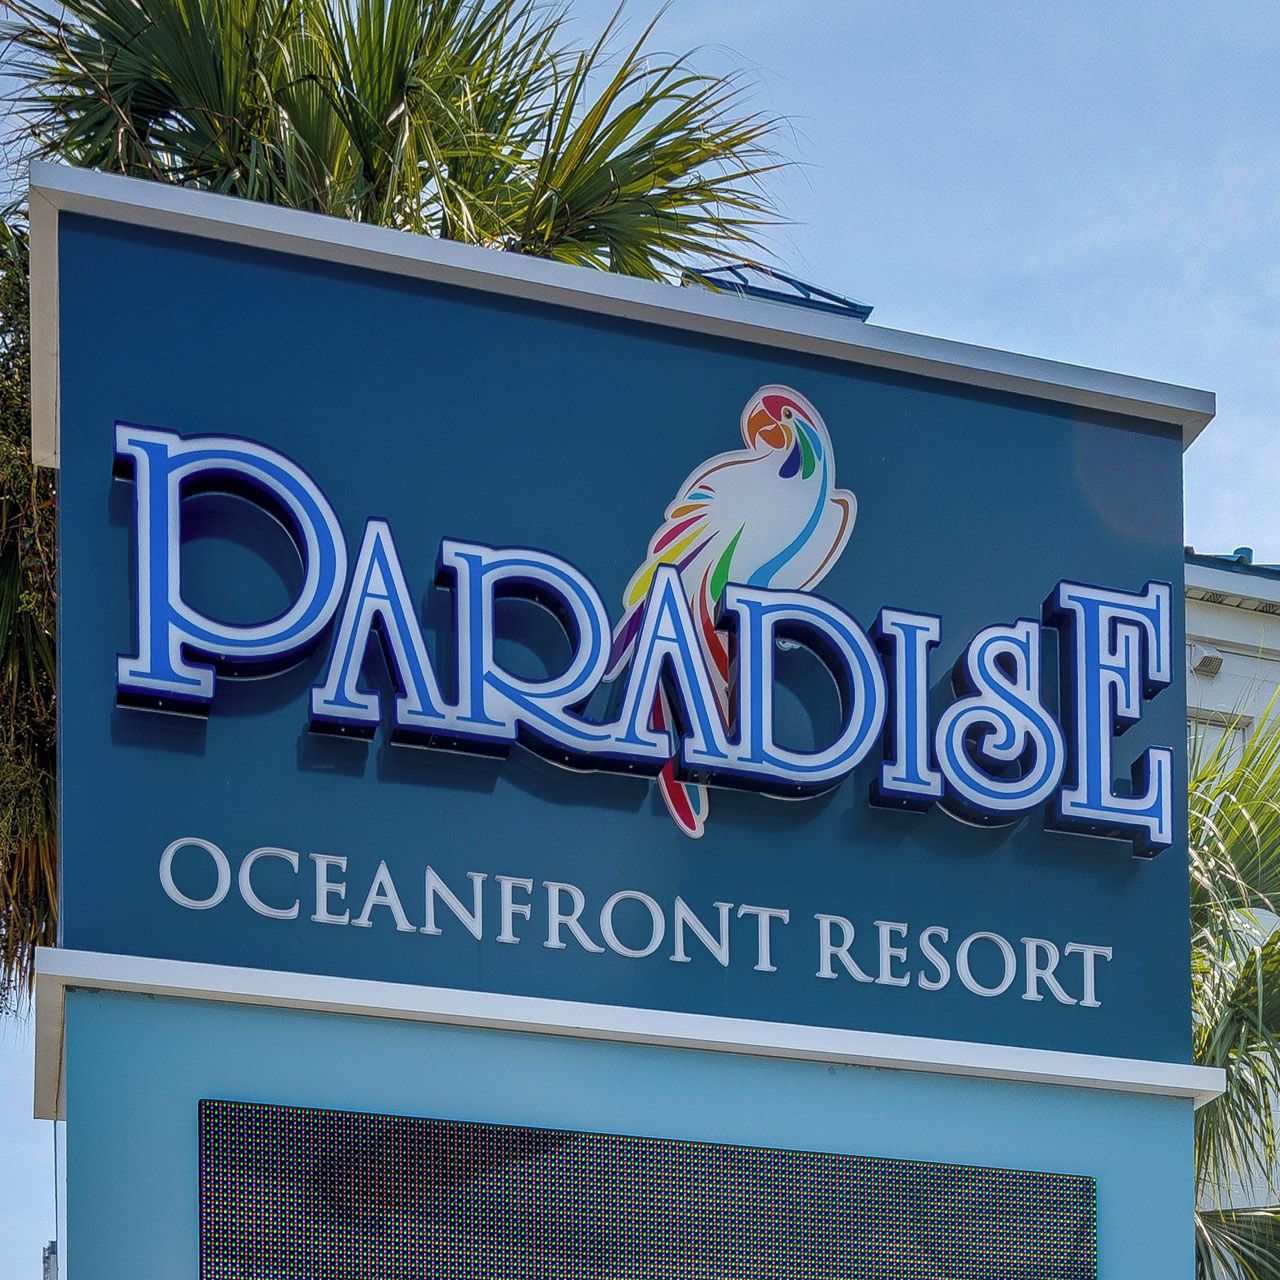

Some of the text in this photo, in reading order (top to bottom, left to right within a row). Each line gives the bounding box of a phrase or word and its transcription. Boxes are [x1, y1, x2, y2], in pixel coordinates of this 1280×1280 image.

[114, 420, 1173, 849] PARADISE
[159, 837, 1113, 1008] OCEANFRONT RESORT
